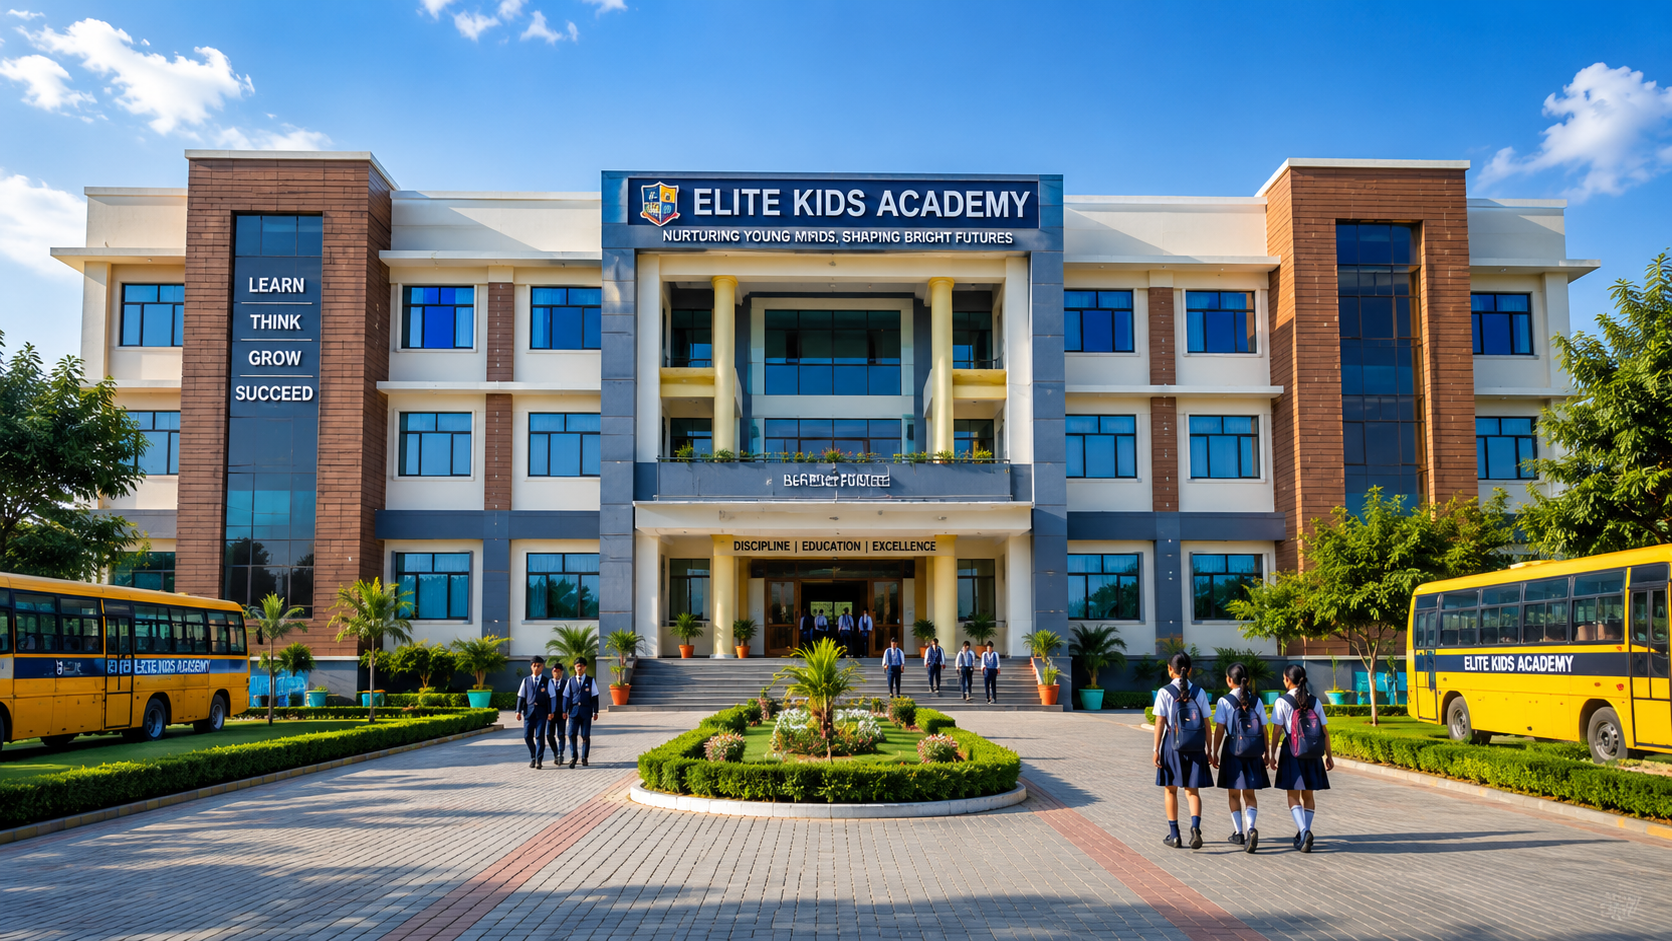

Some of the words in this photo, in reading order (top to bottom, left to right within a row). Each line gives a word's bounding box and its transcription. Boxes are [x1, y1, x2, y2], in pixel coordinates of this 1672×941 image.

[693, 187, 781, 216] ELITE
[793, 189, 866, 217] KIDS
[876, 190, 1031, 218] ACADEMY
[662, 229, 740, 242] NURTURING
[743, 230, 791, 242] YOUNG
[842, 230, 901, 244] SHAPING
[904, 231, 951, 244] BRIGHT
[955, 231, 1013, 244] FUTURES
[248, 277, 305, 293] LEARN
[249, 314, 302, 330] THINK
[248, 350, 302, 366] GROW
[235, 385, 314, 401] SUCCEED
[733, 540, 790, 551] DISCIPLINE
[802, 540, 860, 551] EDUCATION
[872, 540, 936, 552] EXCELLENCE
[1464, 656, 1489, 671] ELITE
[1491, 655, 1515, 671] KIDS
[1517, 655, 1574, 672] ACADEMY
